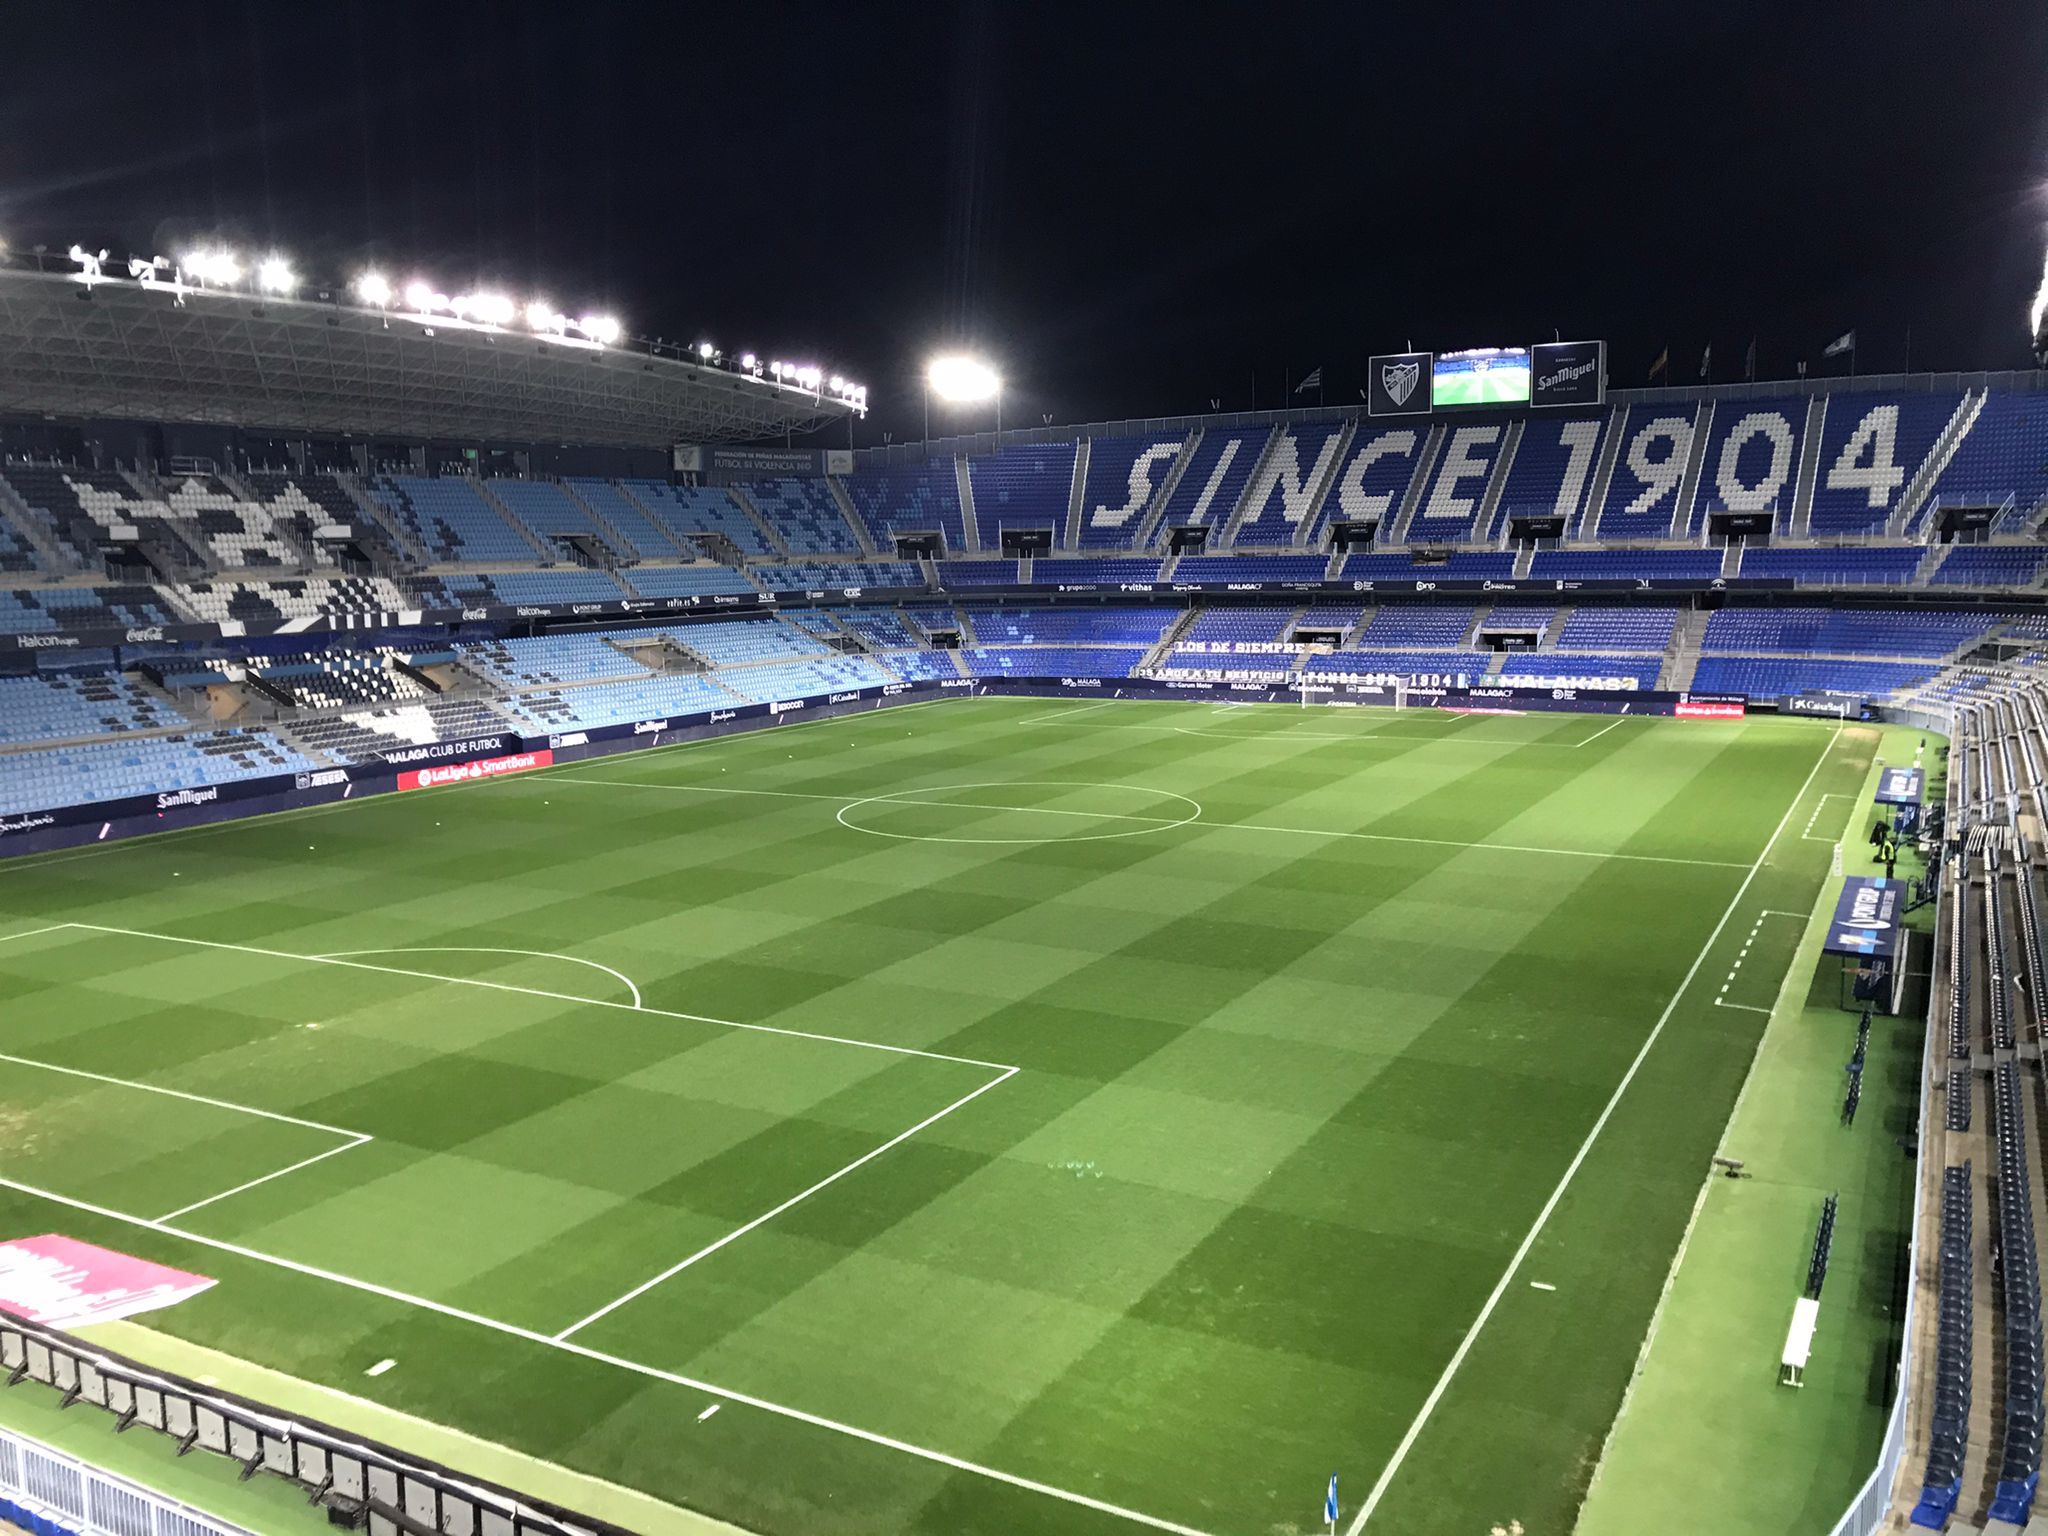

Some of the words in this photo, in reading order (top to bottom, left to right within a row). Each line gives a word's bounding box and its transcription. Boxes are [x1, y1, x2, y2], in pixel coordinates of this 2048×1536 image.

[755, 461, 796, 470] VIOLENCIA
[1091, 426, 1500, 527] SINCE
[1553, 403, 1906, 517] 1904
[1127, 583, 1153, 592] vithas
[758, 592, 775, 601] SUR
[1210, 643, 1230, 654] DE
[1235, 643, 1305, 654] SIEMPRE
[1226, 671, 1285, 681] SERVICIO
[1410, 675, 1452, 688] 1904
[430, 744, 454, 758] CLUB
[456, 744, 468, 755] DE
[469, 738, 502, 753] FUTBOL
[432, 767, 469, 783] LaLiga
[482, 757, 537, 774] SmartBank
